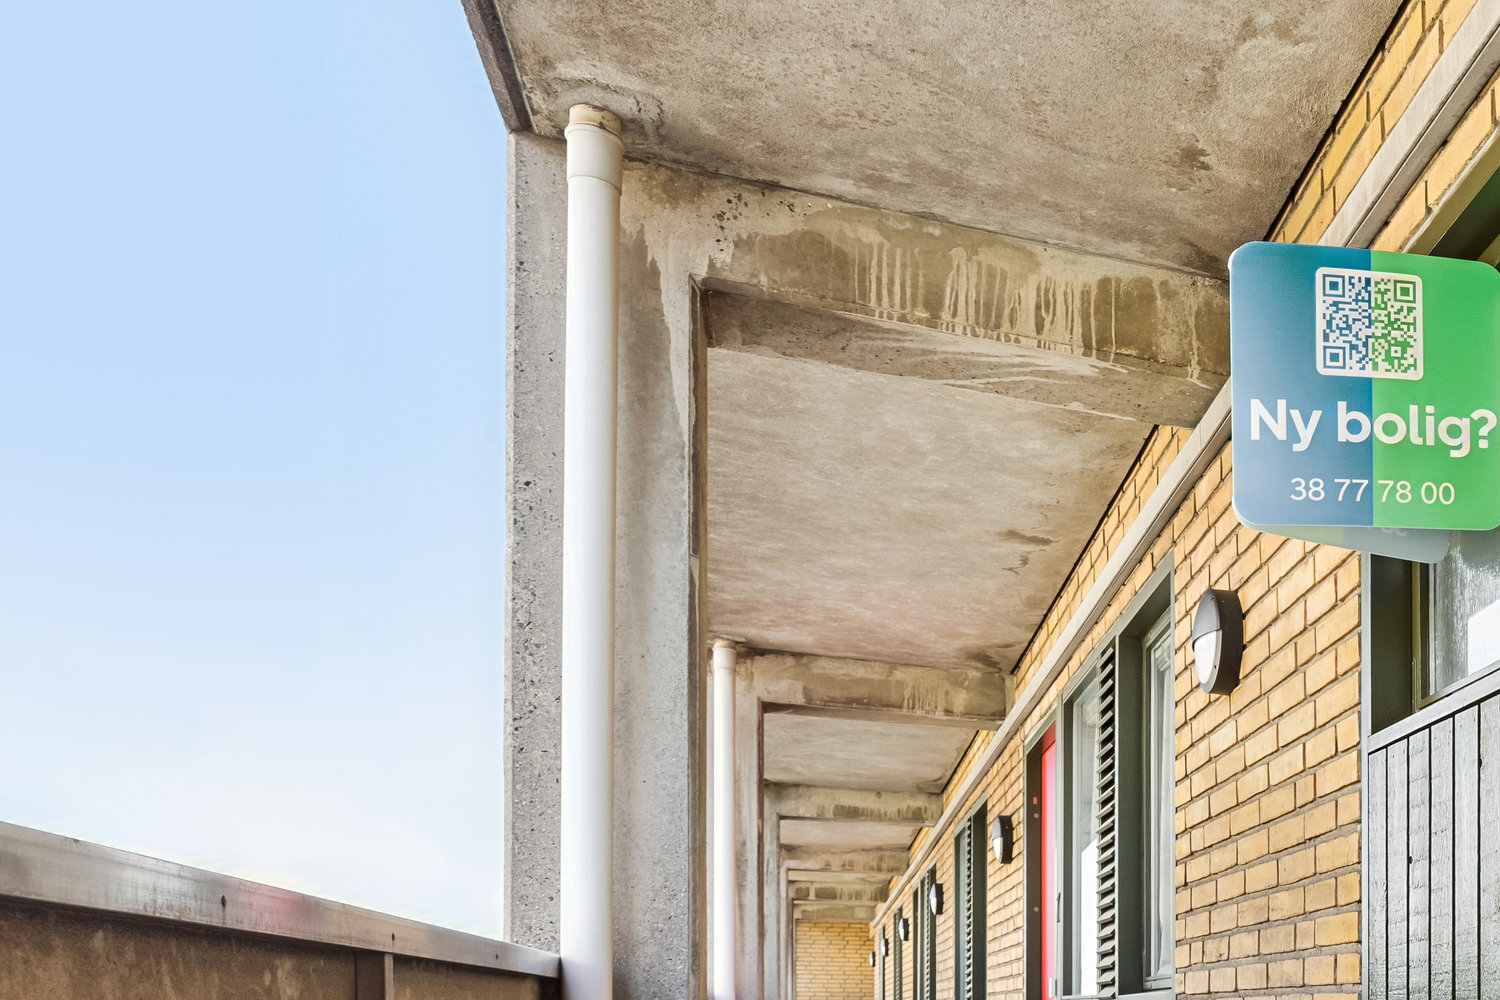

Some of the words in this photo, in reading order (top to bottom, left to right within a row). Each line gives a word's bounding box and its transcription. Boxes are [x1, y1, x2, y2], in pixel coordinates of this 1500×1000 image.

[1249, 398, 1323, 452] Ny
[1337, 401, 1498, 458] bolig?
[1289, 477, 1326, 502] 38
[1334, 478, 1369, 502] 77
[1377, 480, 1412, 504] 78
[1420, 481, 1456, 505] 00
